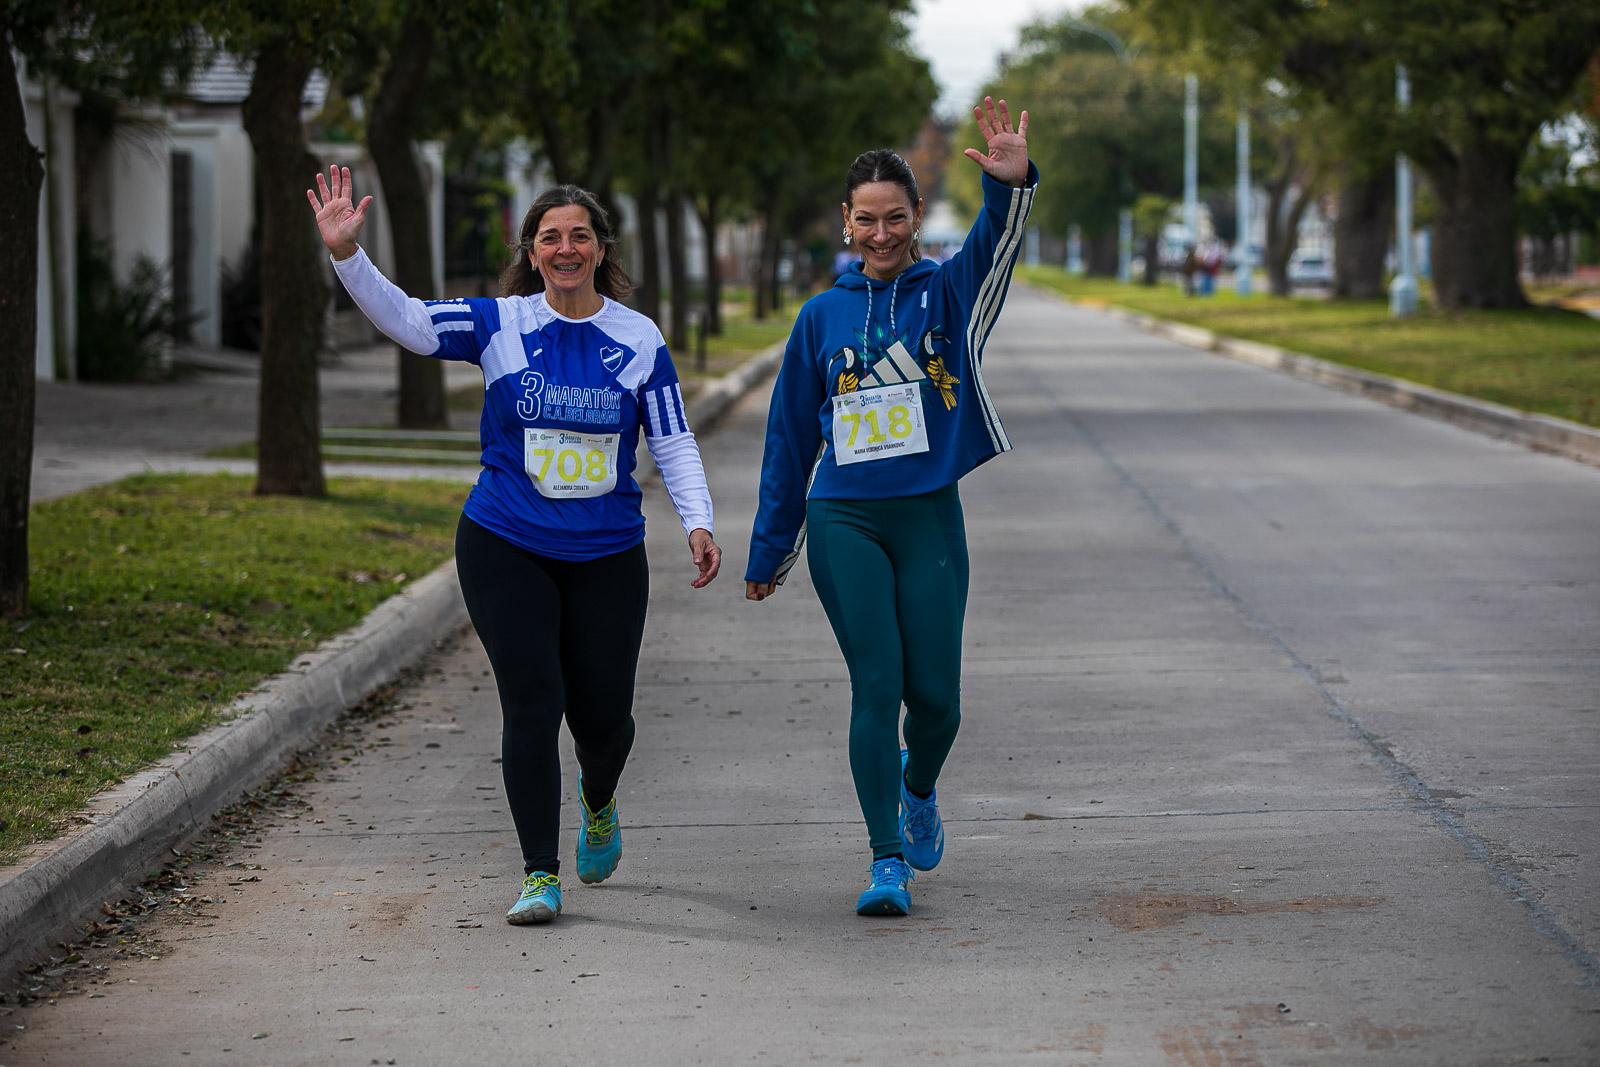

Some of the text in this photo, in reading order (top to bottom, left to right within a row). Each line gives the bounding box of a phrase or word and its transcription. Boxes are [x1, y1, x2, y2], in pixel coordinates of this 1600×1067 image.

[517, 371, 622, 421] 3 MARATÓN
[841, 405, 913, 448] 718
[533, 448, 608, 482] 708
[854, 447, 866, 455] MARIA
